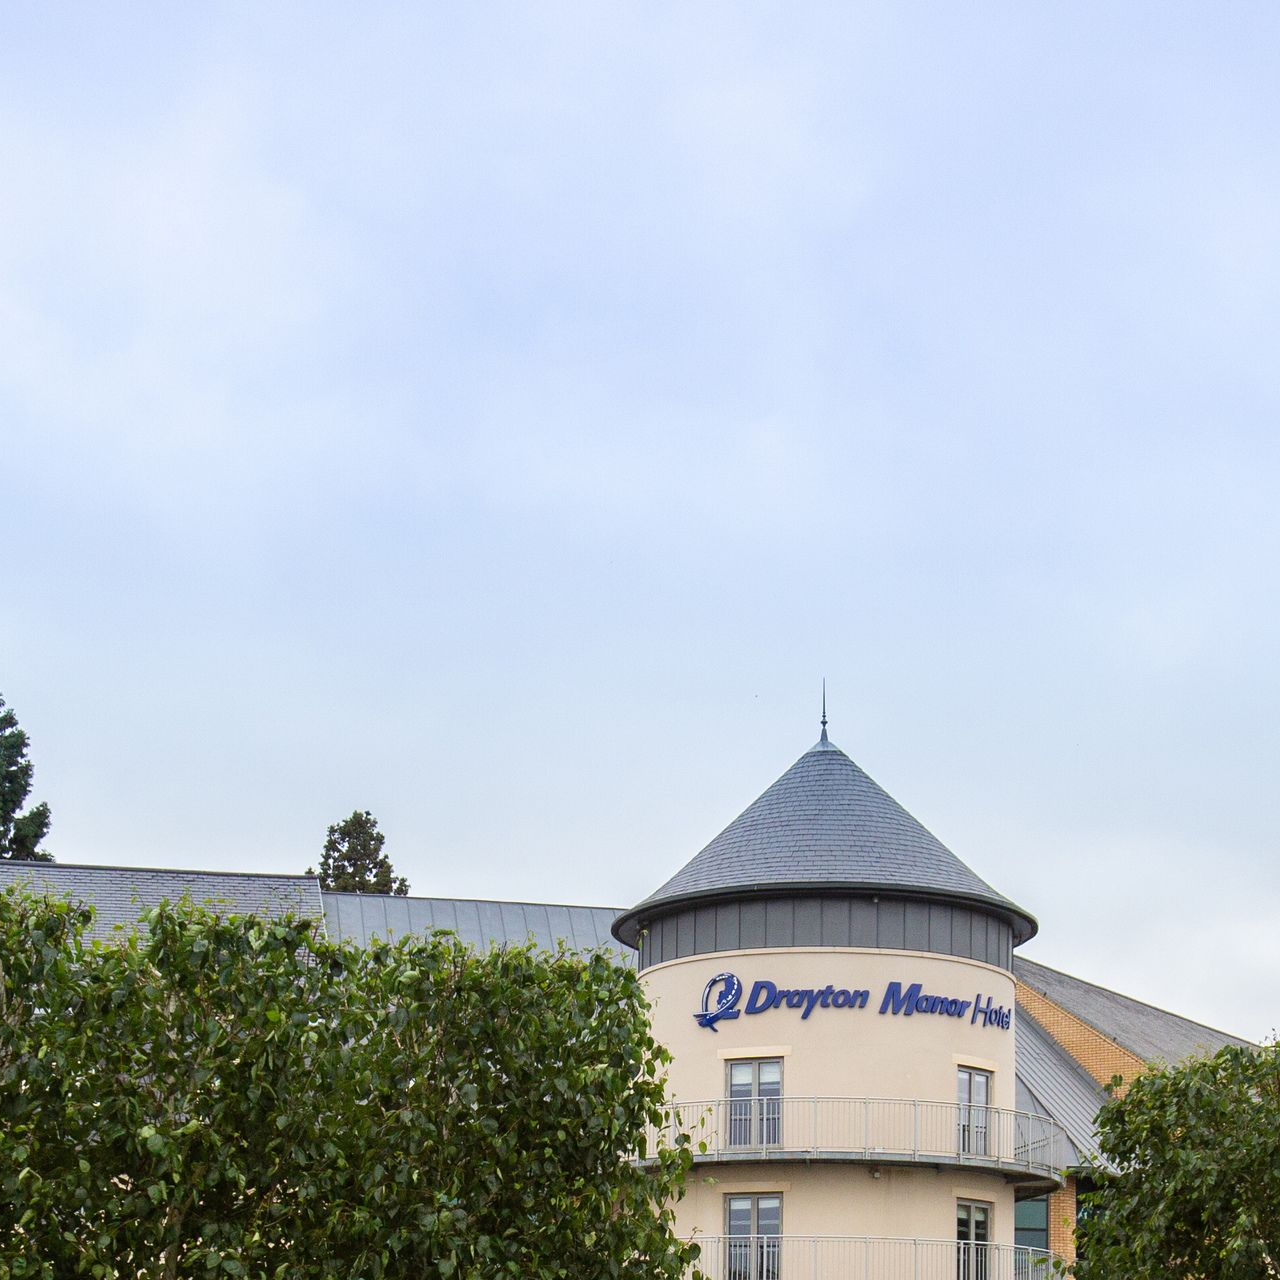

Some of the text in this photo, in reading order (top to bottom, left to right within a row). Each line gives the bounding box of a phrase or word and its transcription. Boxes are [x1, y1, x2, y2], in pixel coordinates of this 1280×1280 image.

[744, 980, 1011, 1030] Drayton Manor Hotel
